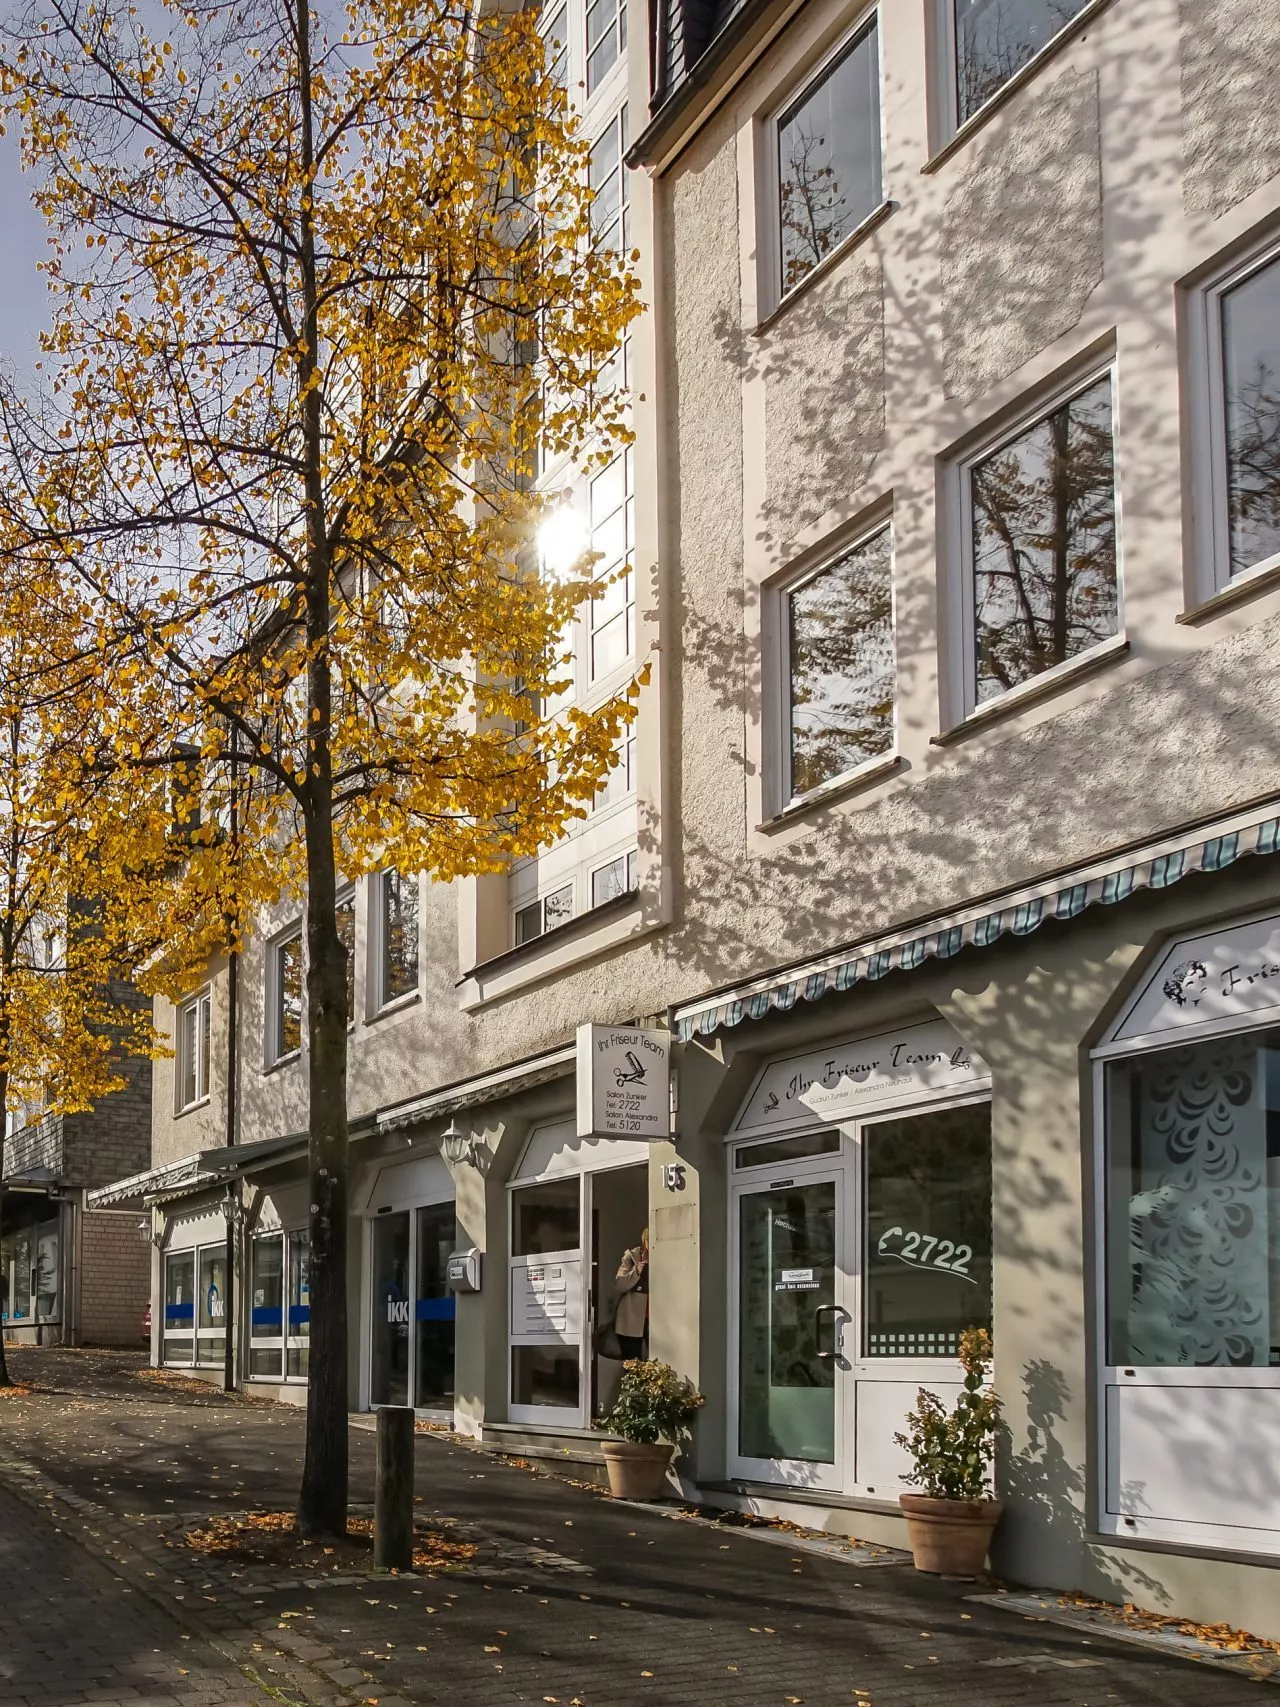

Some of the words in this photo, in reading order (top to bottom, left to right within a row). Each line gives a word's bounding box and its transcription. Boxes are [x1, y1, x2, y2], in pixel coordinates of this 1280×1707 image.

[597, 1039, 609, 1052] Ihr
[610, 1034, 638, 1047] Friseur
[640, 1035, 665, 1058] Team
[786, 1073, 817, 1100] Ihr
[823, 1060, 880, 1083] Friseur
[890, 1043, 942, 1068] Team
[606, 1090, 625, 1099] Salon
[625, 1092, 647, 1101] Zunker
[809, 1095, 830, 1105] Gudrun
[830, 1090, 849, 1101] Zunker
[854, 1083, 885, 1095] Alexandra
[885, 1077, 913, 1088] Neuhaus
[605, 1110, 623, 1119] Salon
[625, 1112, 658, 1122] Alexandra
[618, 1099, 641, 1111] 2722
[618, 1119, 641, 1131] 5120
[661, 1163, 677, 1189] 15
[901, 1232, 972, 1274] 2722
